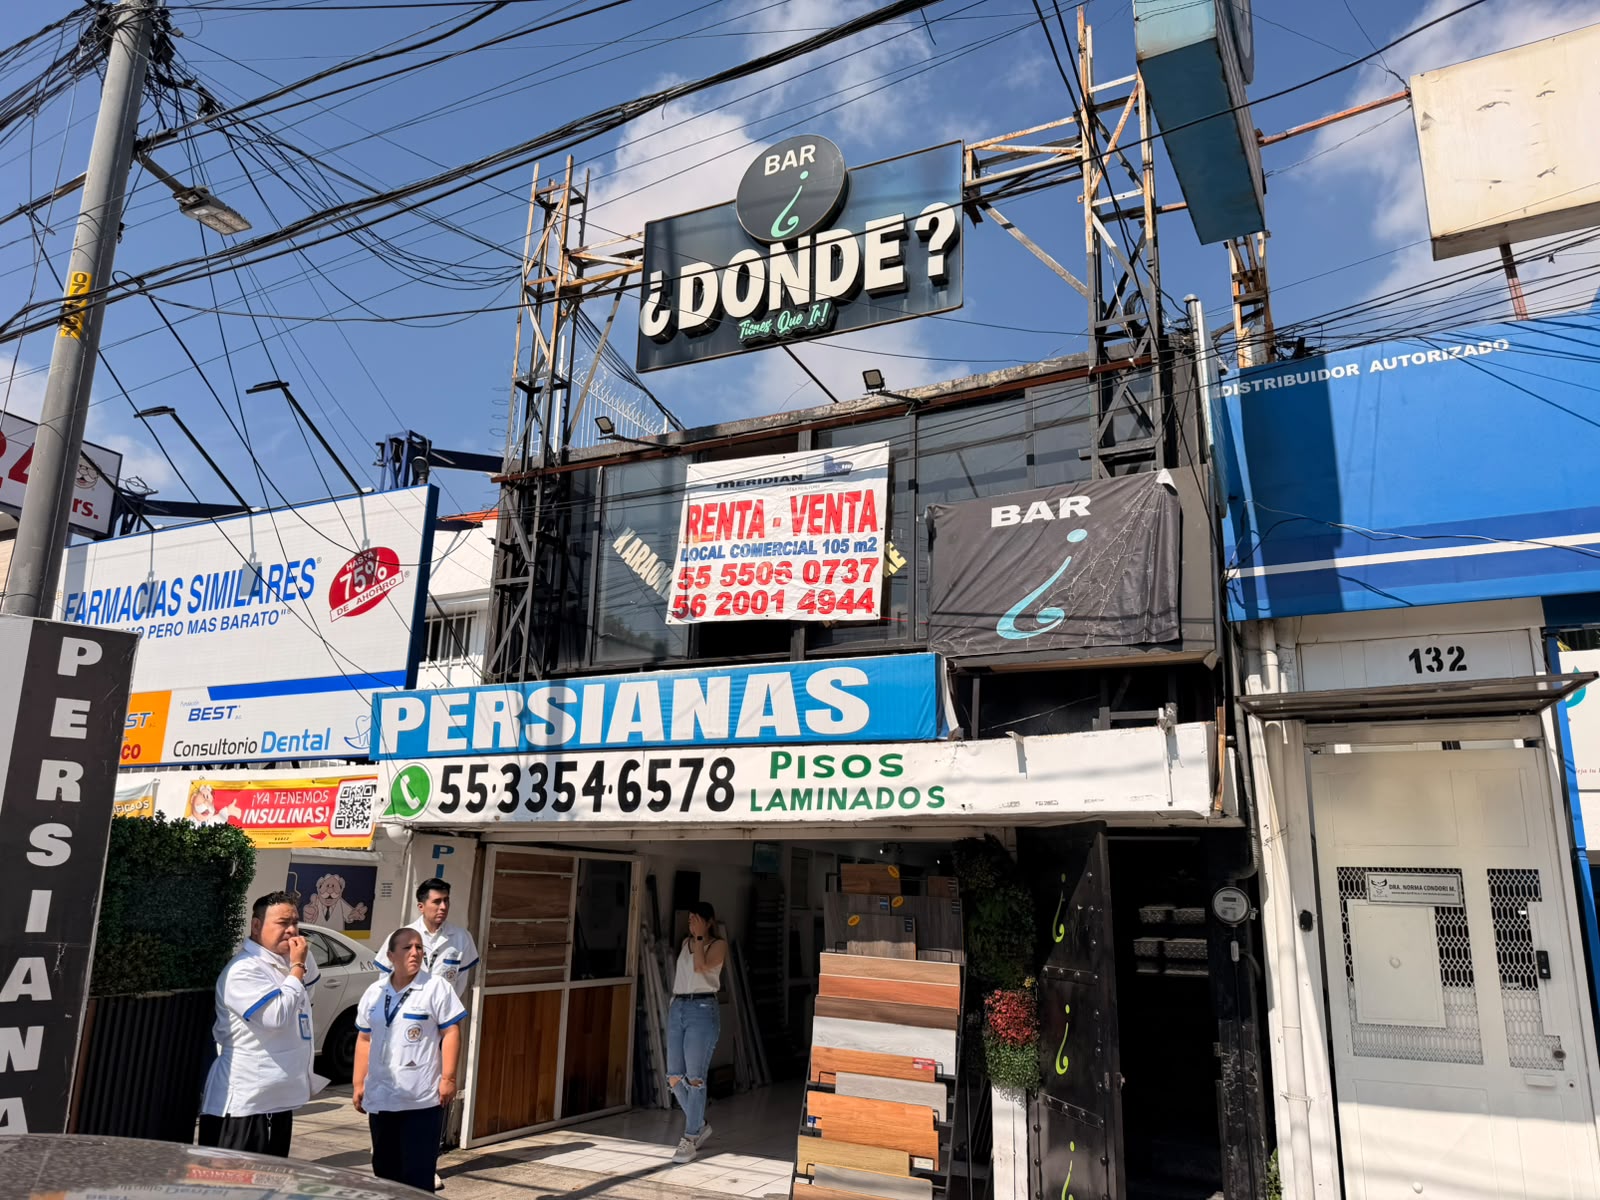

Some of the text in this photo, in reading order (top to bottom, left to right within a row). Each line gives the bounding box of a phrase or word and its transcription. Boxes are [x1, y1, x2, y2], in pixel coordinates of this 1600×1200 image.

[764, 144, 816, 176] BAR
[639, 201, 957, 337] ¿DONDE?
[739, 302, 829, 339] Tienes Que Ir!
[1217, 339, 1510, 398] DISTRIBUIDOR AUTORIZADO
[72, 498, 99, 520] rs.
[684, 499, 765, 543] RENTA
[791, 489, 878, 536] VENTA
[991, 495, 1091, 528] BAR
[346, 551, 374, 571] HASTA
[612, 527, 674, 602] KARAOK
[680, 537, 878, 562] LOCAL COMERCIAL 105 m2
[340, 555, 387, 600] 75%
[677, 565, 711, 590] 55
[720, 561, 793, 588] 5506
[803, 557, 880, 585] 0737
[64, 557, 316, 625] FARMACIAS SIMILARES
[336, 577, 397, 616] DE AHORRO
[672, 587, 875, 619] 56 2001 4944
[147, 621, 183, 639] PERO
[187, 616, 217, 634] MAS
[1409, 645, 1468, 673] 132
[188, 705, 238, 721] BEST
[379, 666, 869, 754] PERSIANAS
[173, 727, 331, 757] Consultorio Dental
[769, 751, 905, 780] PISOS
[252, 789, 329, 806] ¡YA TENEMOS
[749, 785, 946, 812] LAMINADOS
[242, 805, 330, 825] INSULINAS!
